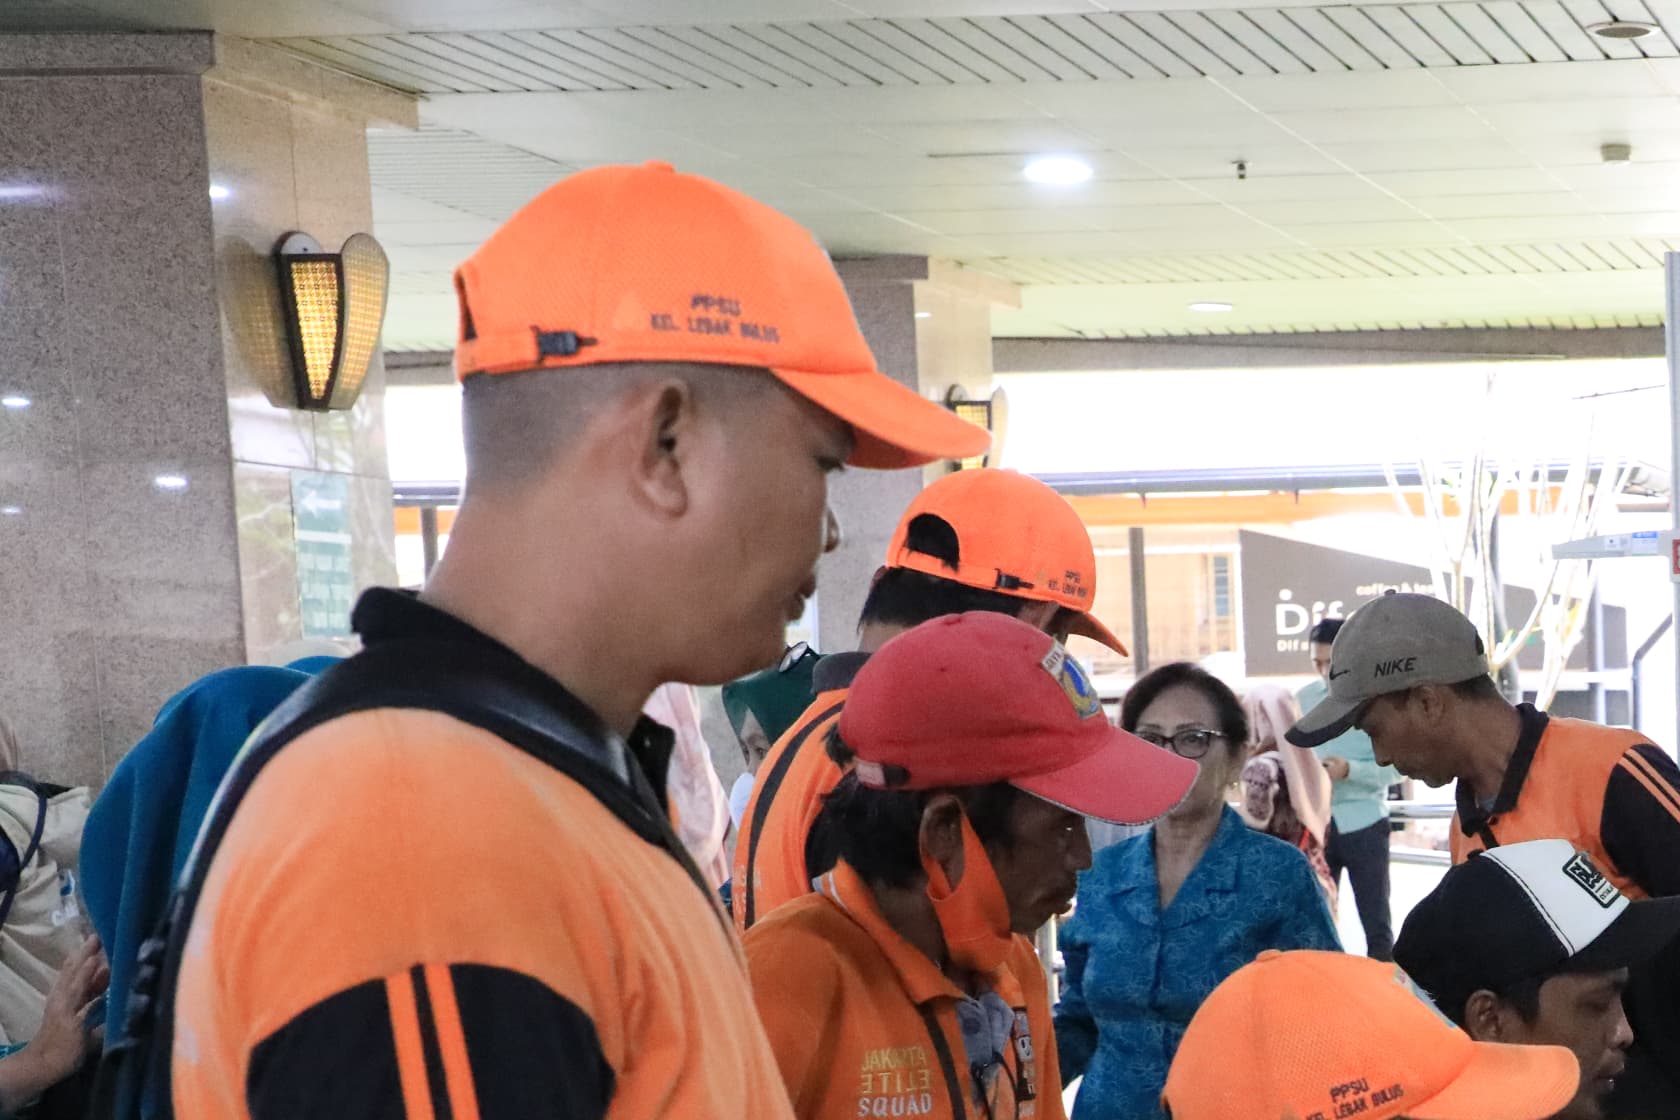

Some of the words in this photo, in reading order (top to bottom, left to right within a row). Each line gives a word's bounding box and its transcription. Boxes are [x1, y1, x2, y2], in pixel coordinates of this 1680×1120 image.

[690, 295, 741, 316] PPSU
[1374, 657, 1417, 678] NIKE
[1330, 1078, 1369, 1103] PPSU
[1334, 1098, 1368, 1119] LEBAK
[1371, 1084, 1405, 1106] BULUS
[858, 1093, 932, 1118] SQUAD
